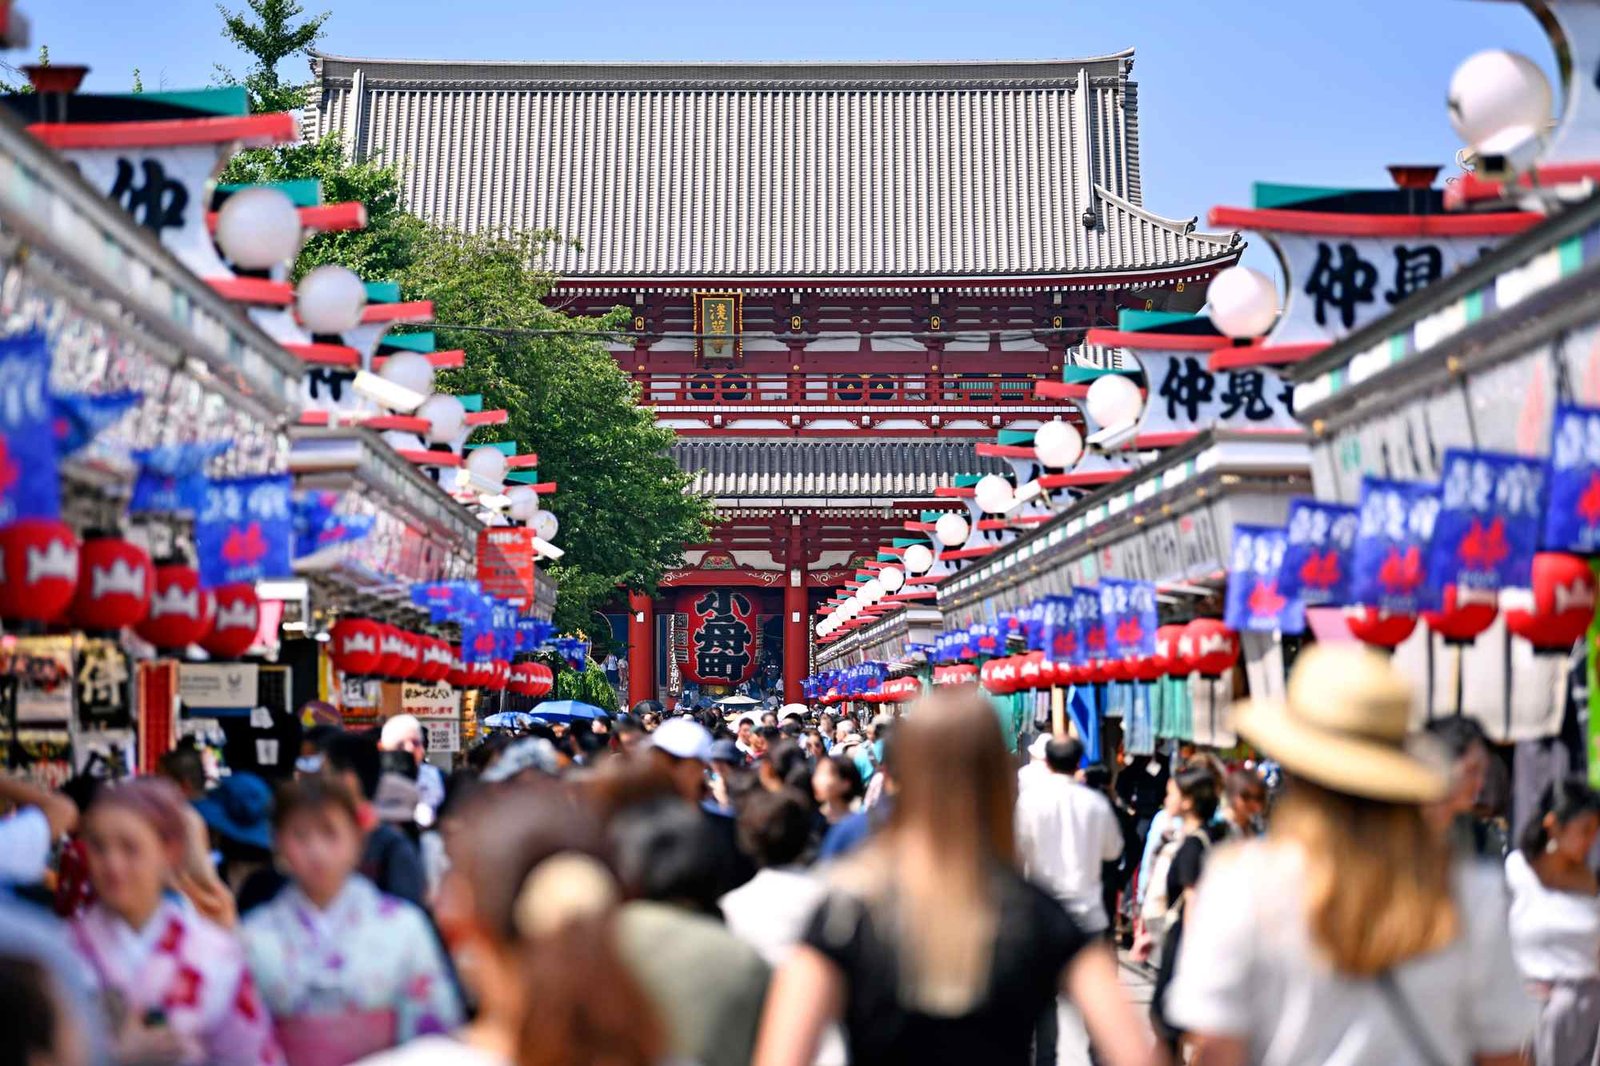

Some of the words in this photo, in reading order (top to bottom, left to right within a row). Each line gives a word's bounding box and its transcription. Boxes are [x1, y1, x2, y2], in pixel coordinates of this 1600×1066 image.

[1305, 242, 1496, 328] 仲見
[693, 587, 752, 682] 小舟町
